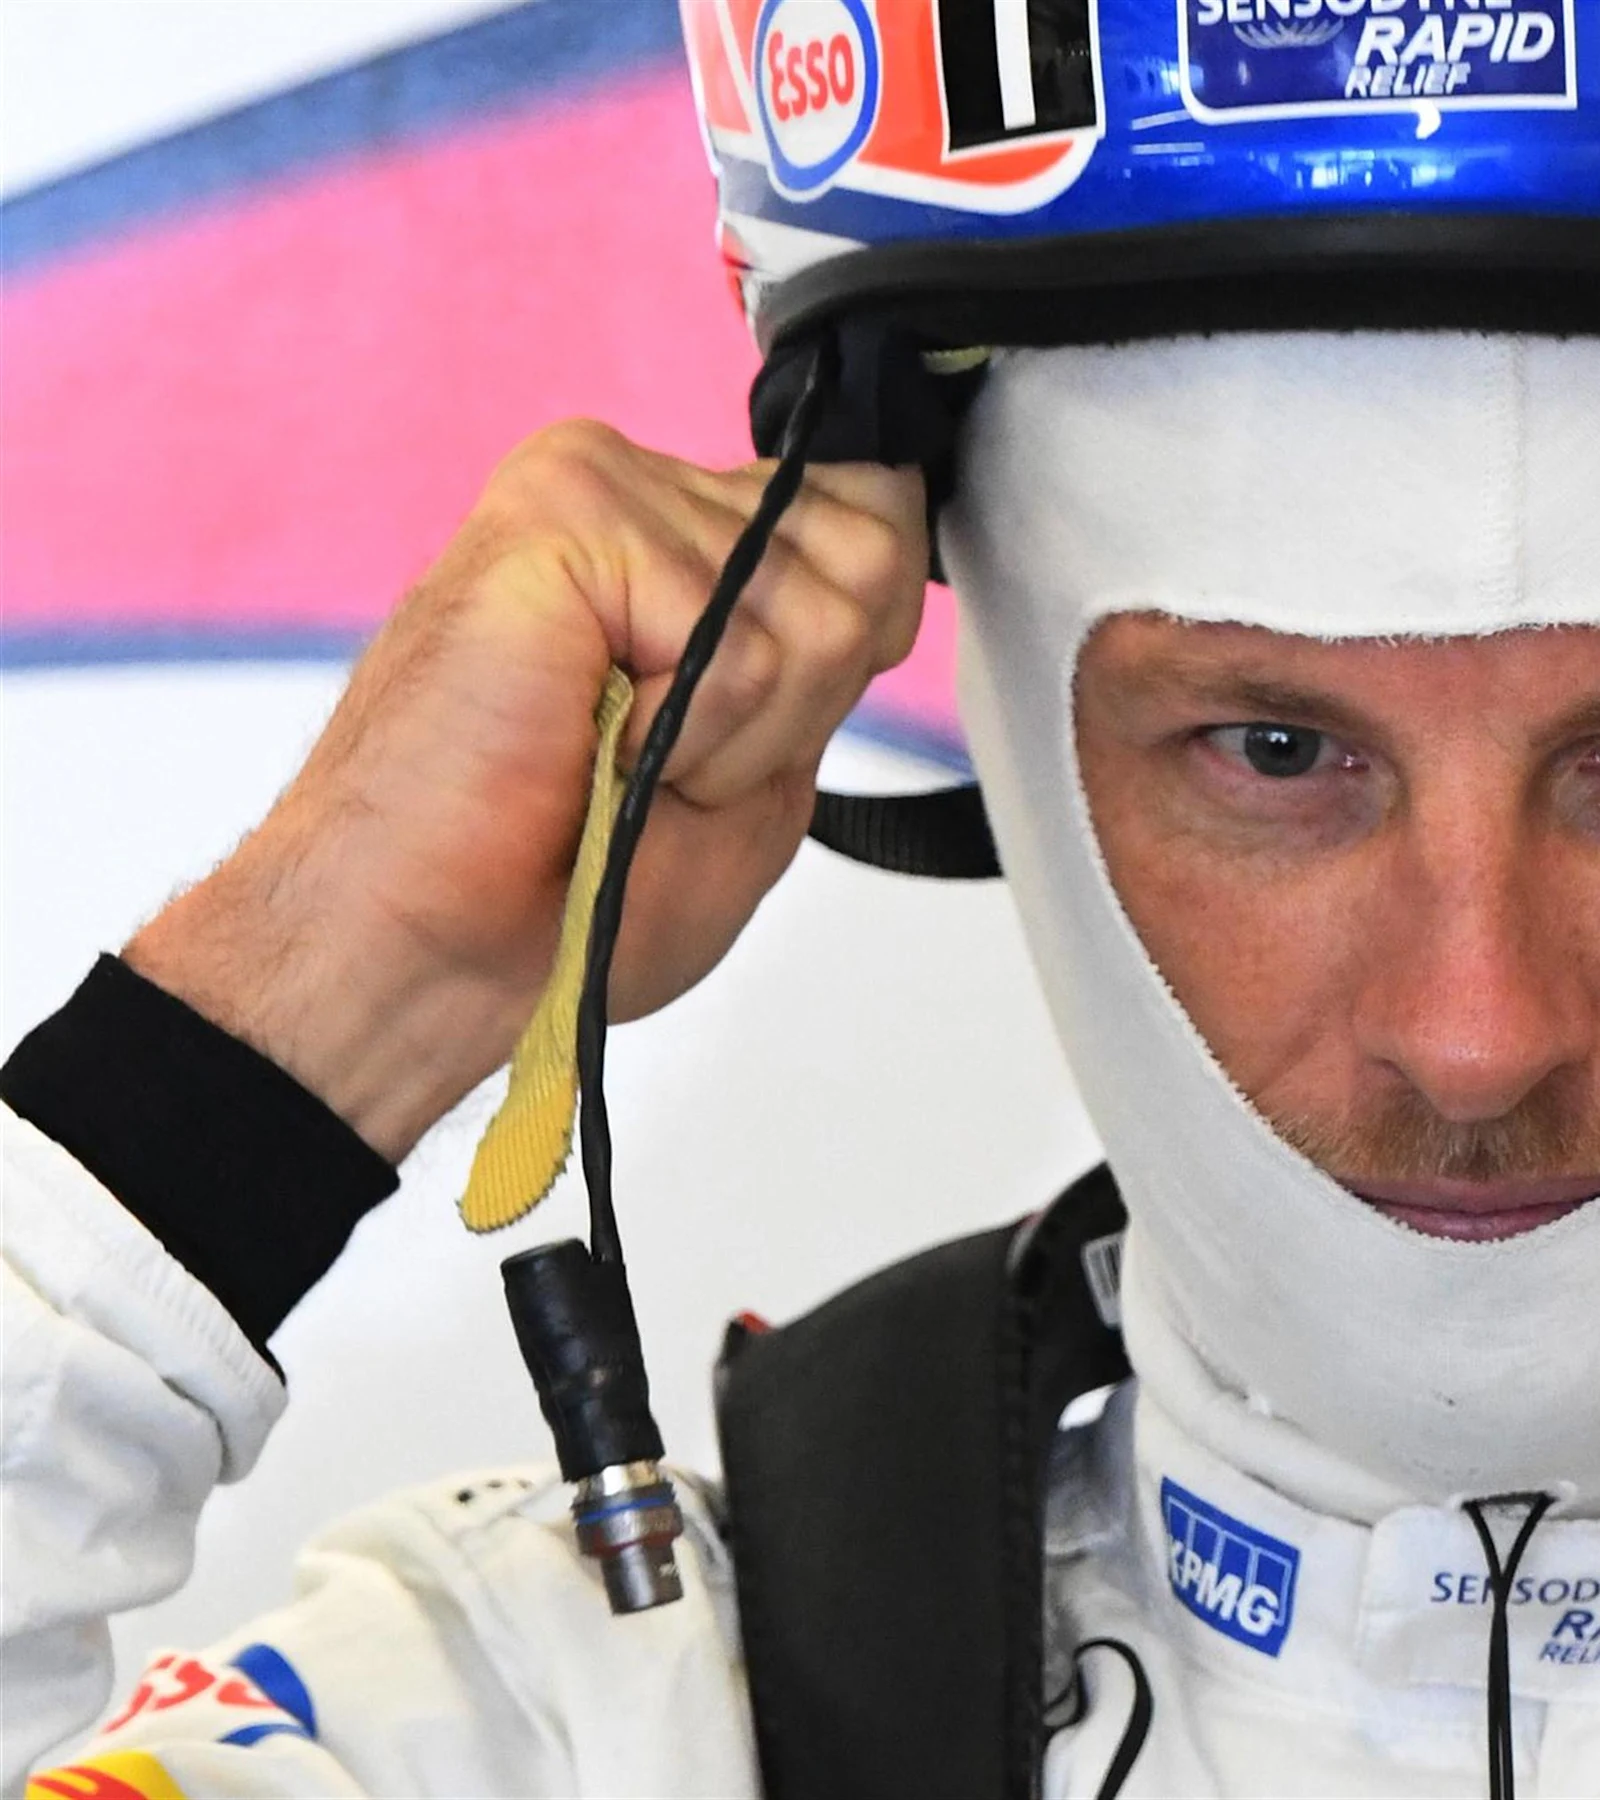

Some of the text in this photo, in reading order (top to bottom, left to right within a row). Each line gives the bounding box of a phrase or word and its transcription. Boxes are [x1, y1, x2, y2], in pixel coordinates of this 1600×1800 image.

[1354, 12, 1556, 66] RAPID
[1345, 62, 1471, 98] RELIEF
[1168, 1534, 1280, 1637] KPMG
